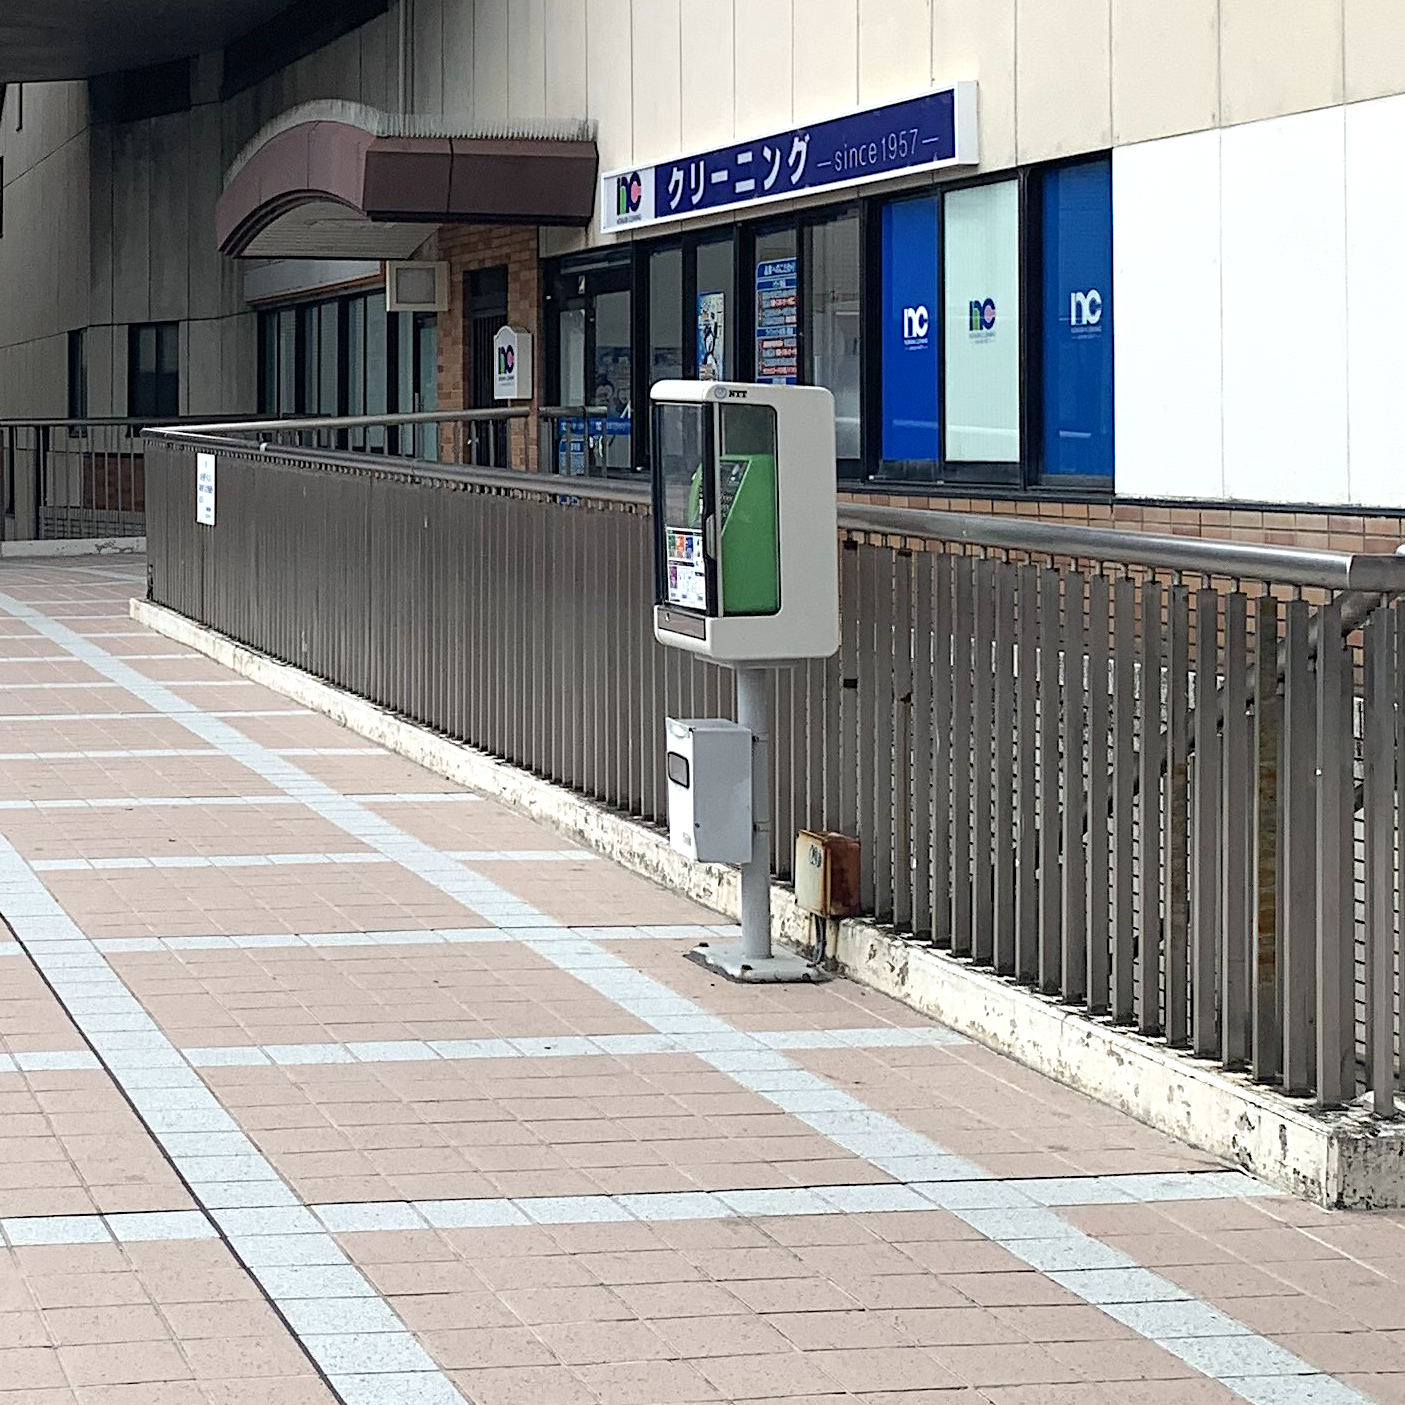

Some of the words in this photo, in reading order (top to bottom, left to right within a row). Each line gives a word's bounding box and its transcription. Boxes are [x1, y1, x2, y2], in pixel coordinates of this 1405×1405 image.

[668, 134, 810, 210] クリーニング
